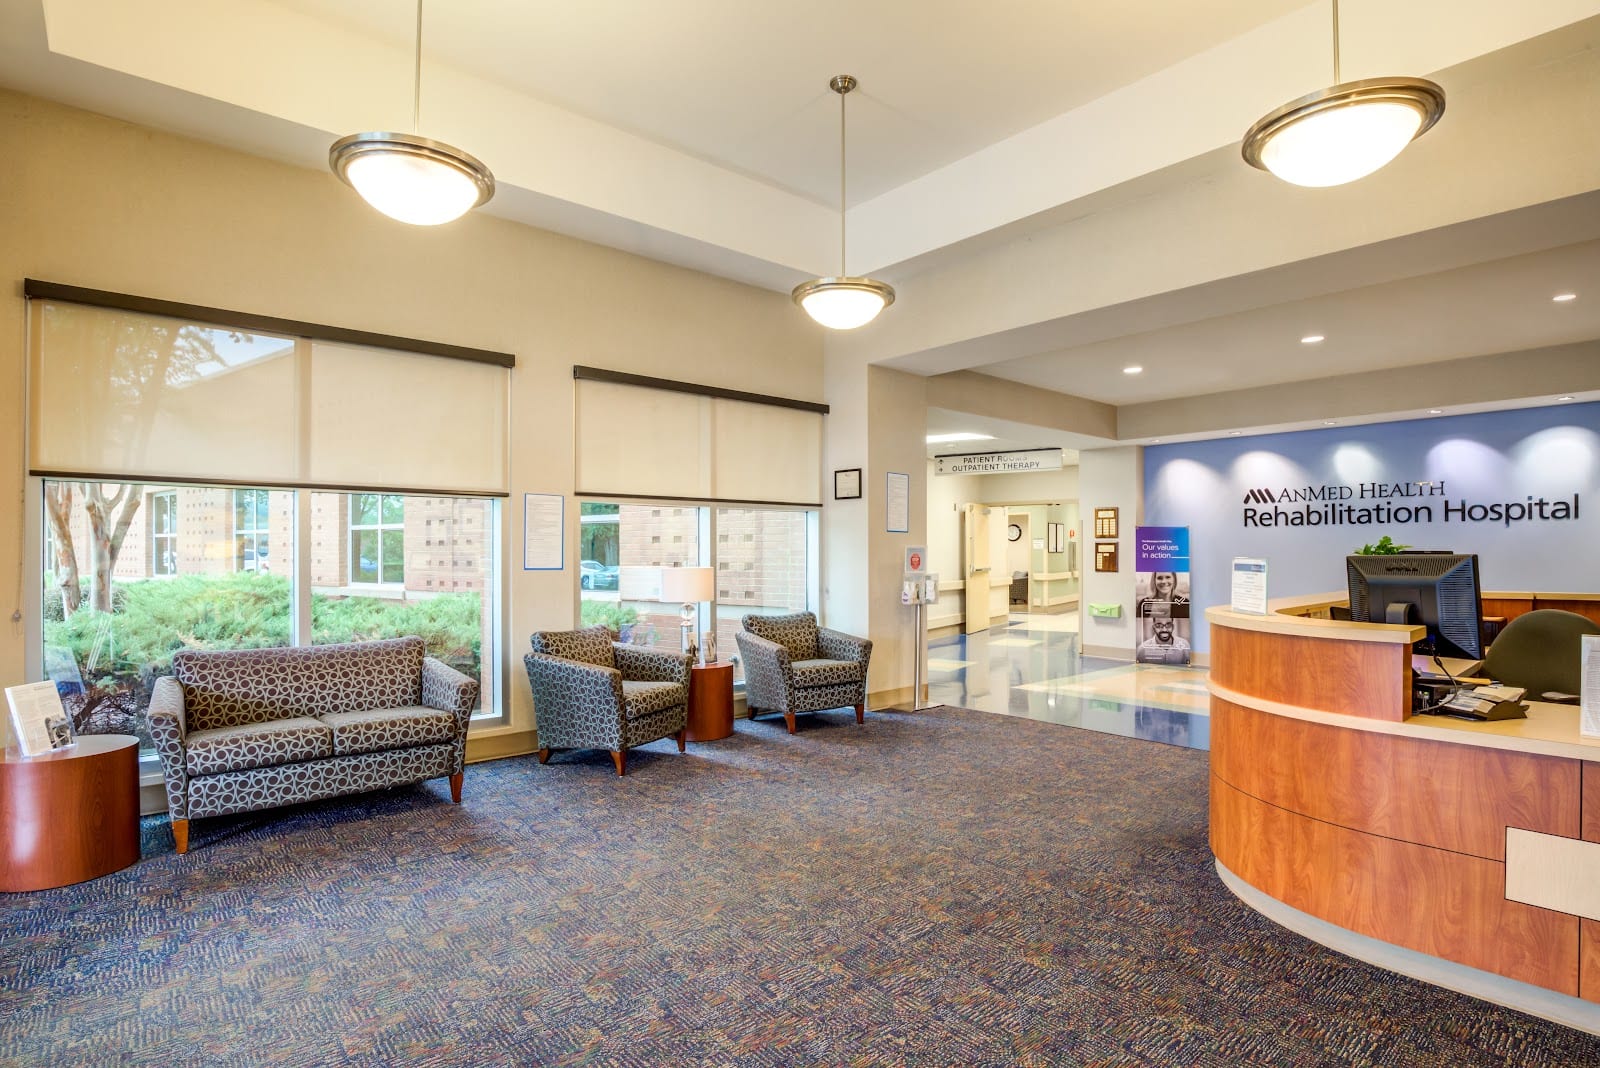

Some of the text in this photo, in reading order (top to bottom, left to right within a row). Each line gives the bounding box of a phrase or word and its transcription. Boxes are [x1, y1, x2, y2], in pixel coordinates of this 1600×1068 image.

[963, 456, 995, 464] PATIENT
[952, 461, 1040, 472] OUTPATIENT THERAPY
[1243, 493, 1579, 528] Rehabilitation Hospital
[1142, 543, 1180, 551] Our values
[1142, 551, 1171, 559] in action
